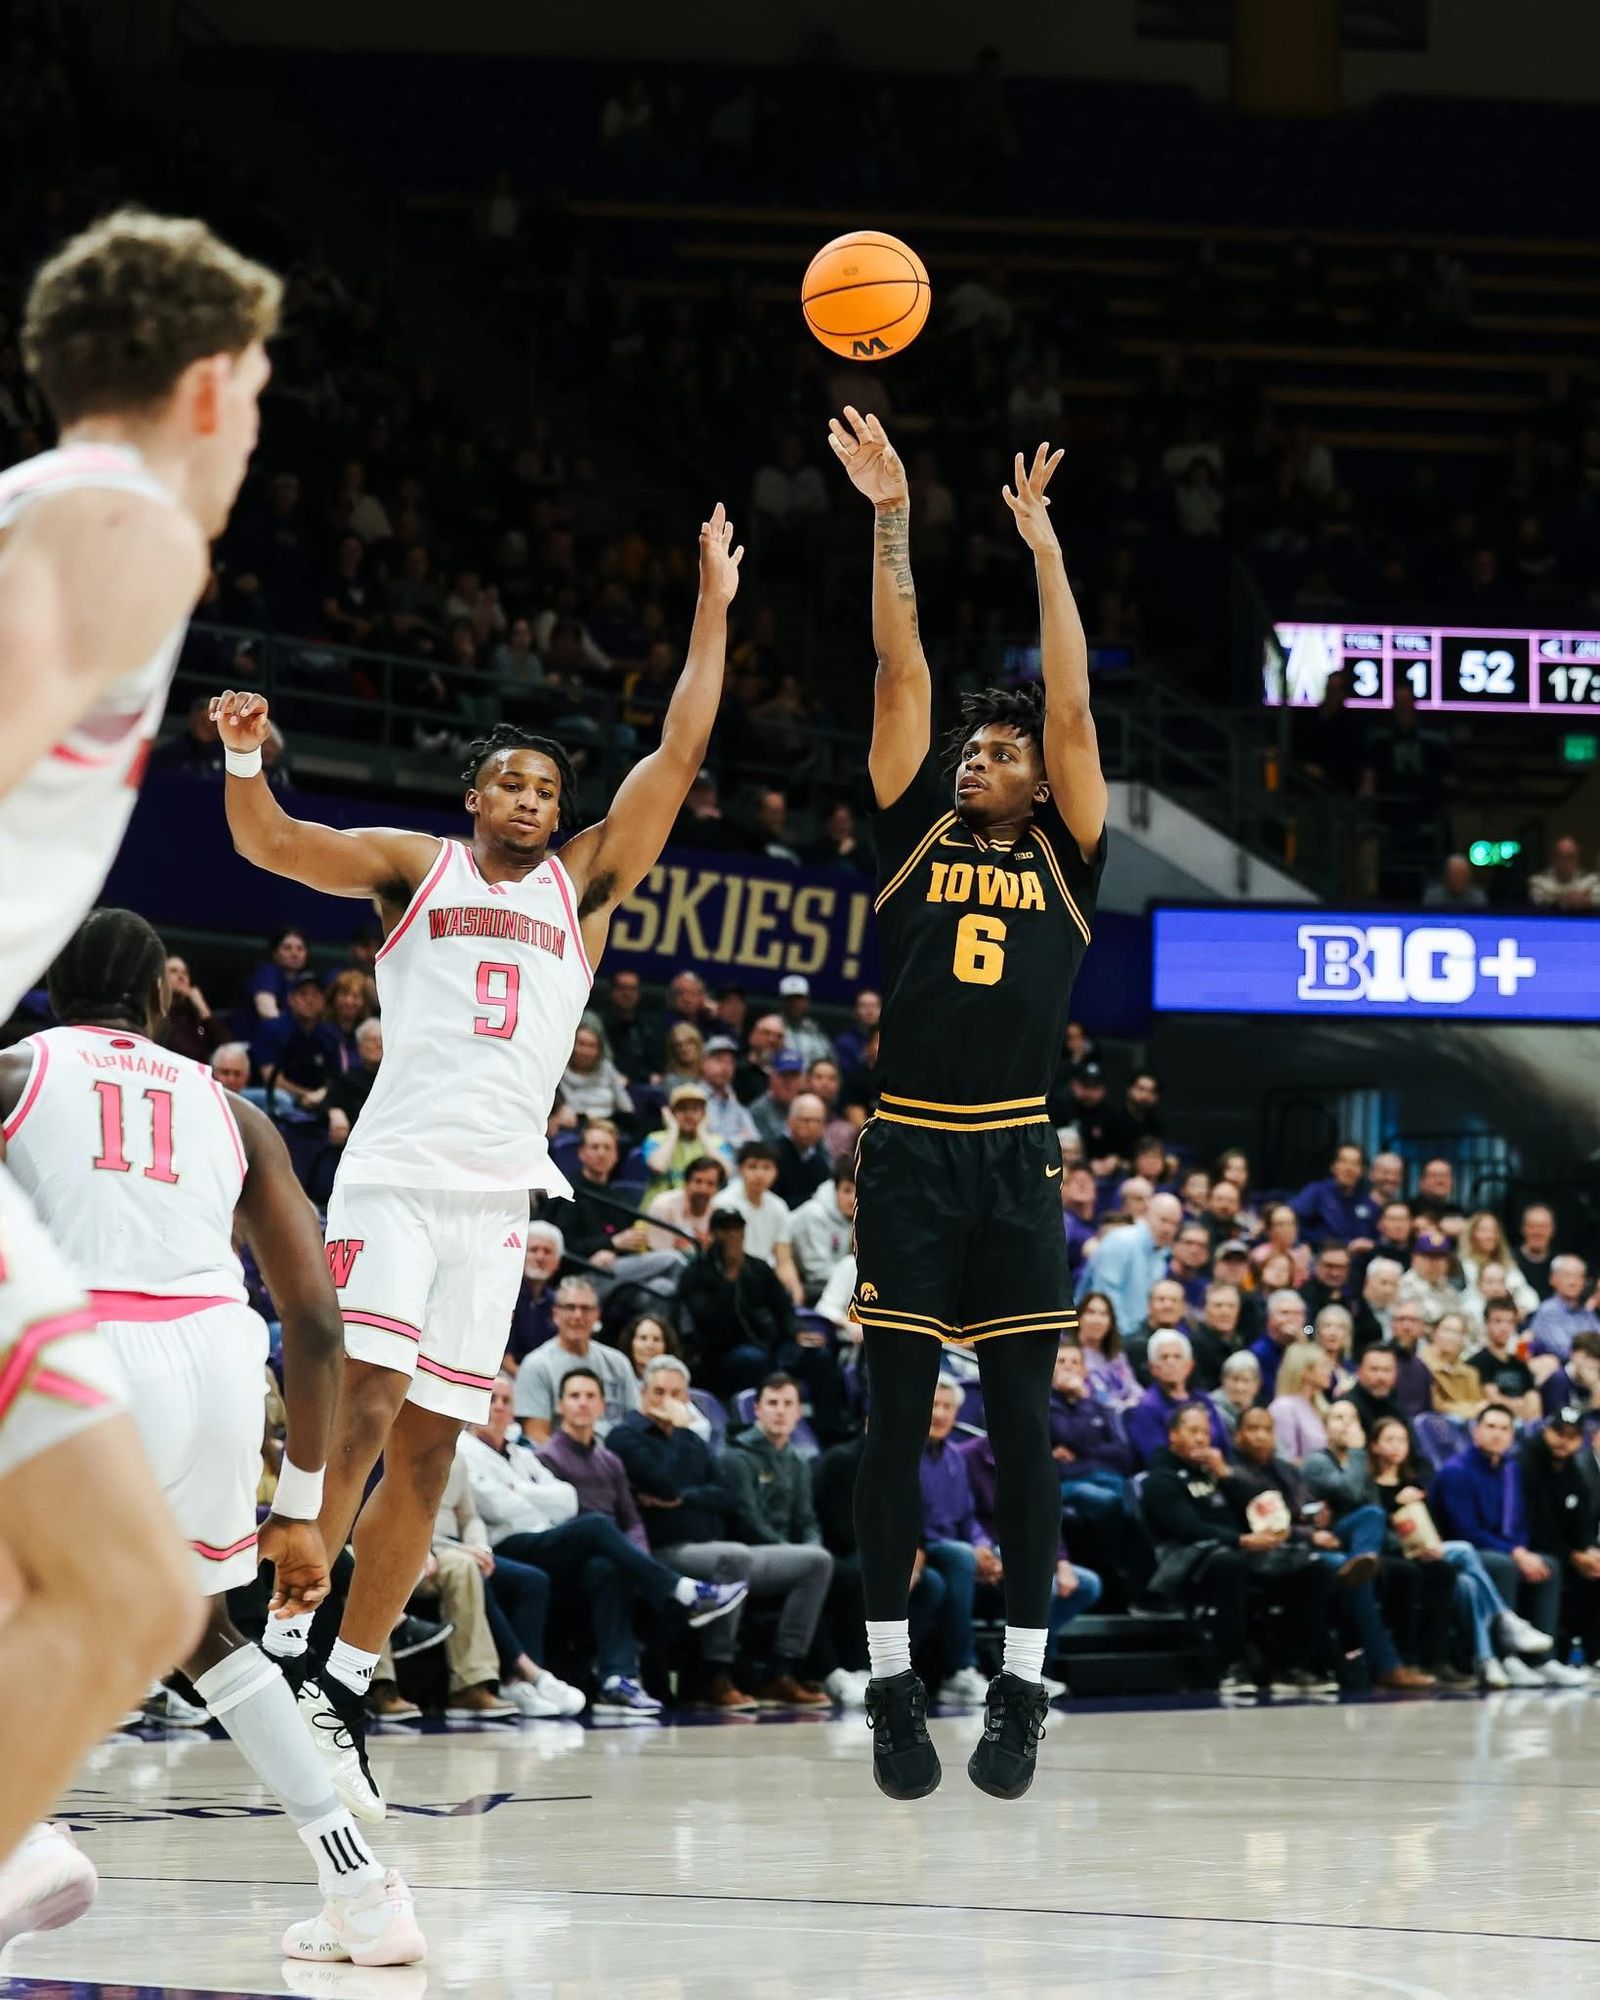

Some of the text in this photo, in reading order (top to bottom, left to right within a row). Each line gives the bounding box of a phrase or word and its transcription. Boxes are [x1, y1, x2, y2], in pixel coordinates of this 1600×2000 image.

[1353, 660, 1379, 696] 3
[1406, 661, 1427, 698] 1
[1459, 650, 1514, 693] 52
[926, 861, 1046, 911] IOWA
[428, 907, 566, 960] WASHINGTON
[952, 913, 1007, 985] 6
[474, 961, 520, 1039] 9
[93, 1080, 179, 1184] 11
